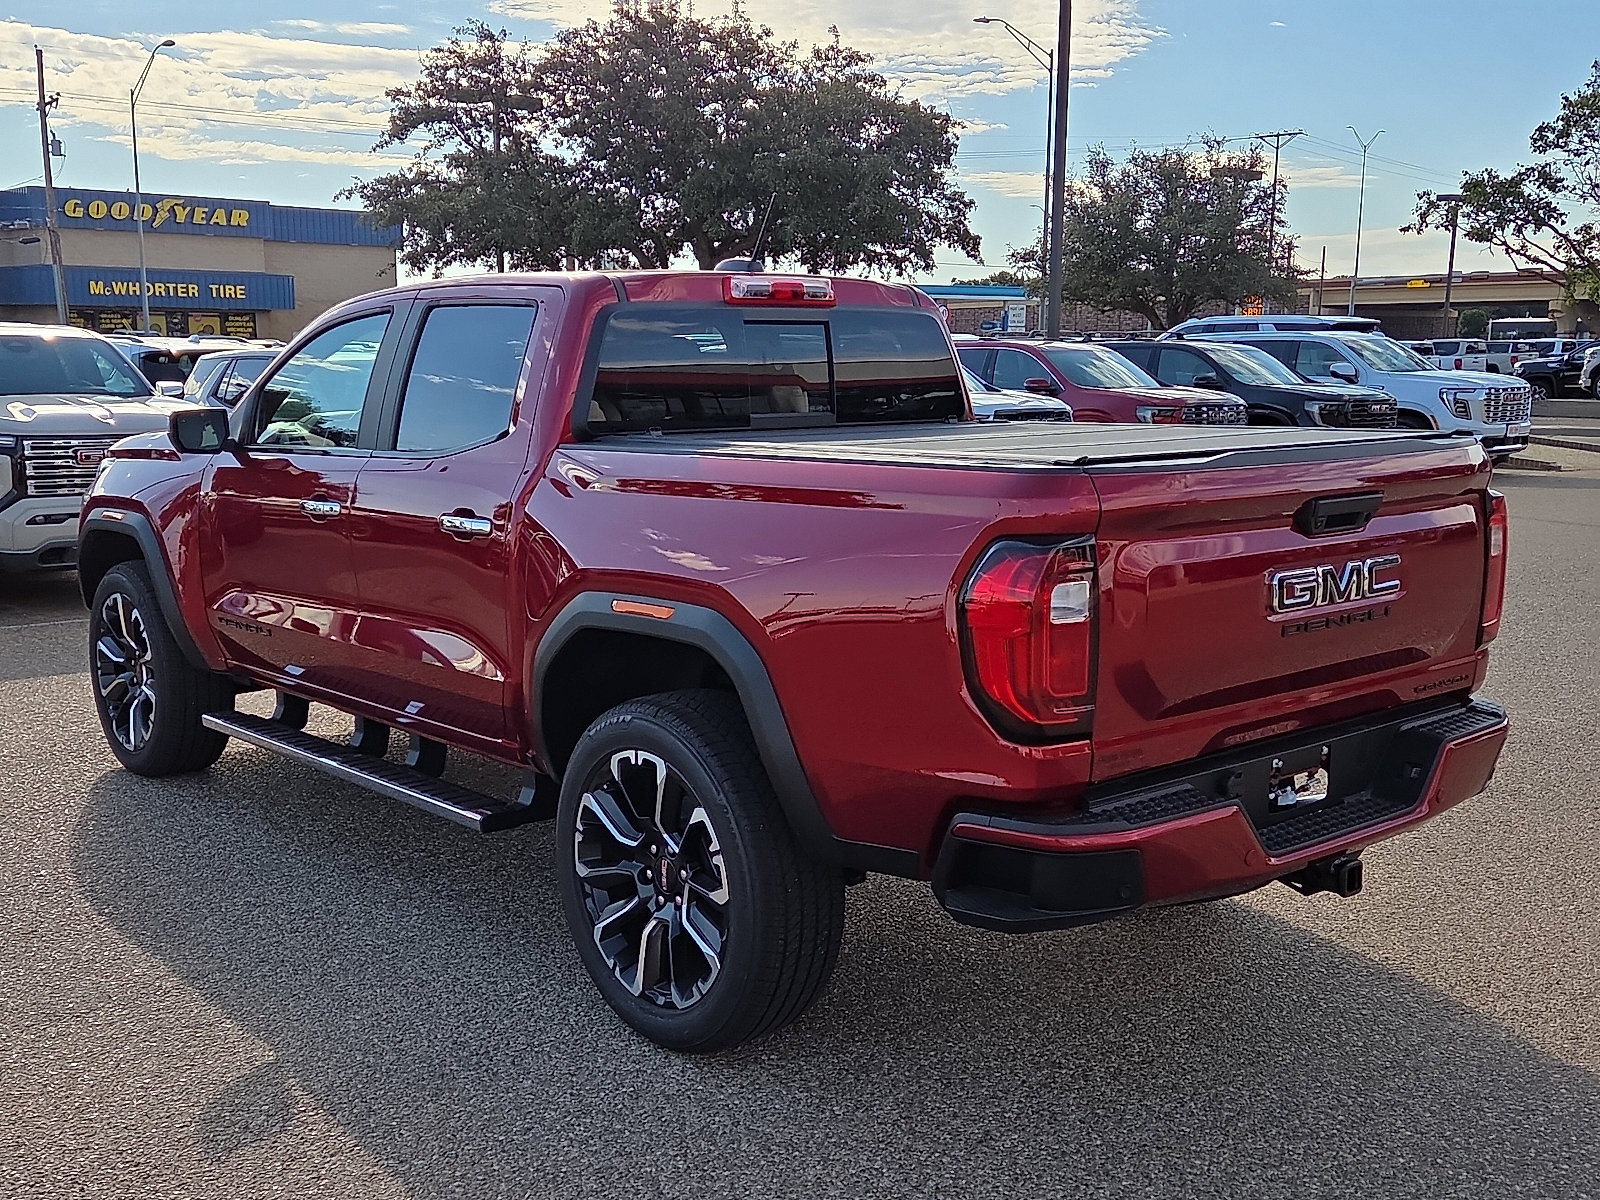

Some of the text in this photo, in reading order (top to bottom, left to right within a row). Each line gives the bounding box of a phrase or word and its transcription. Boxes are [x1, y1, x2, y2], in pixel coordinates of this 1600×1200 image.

[209, 284, 246, 299] TIRE
[1272, 553, 1402, 613] GMC
[1280, 605, 1392, 638] DENALI
